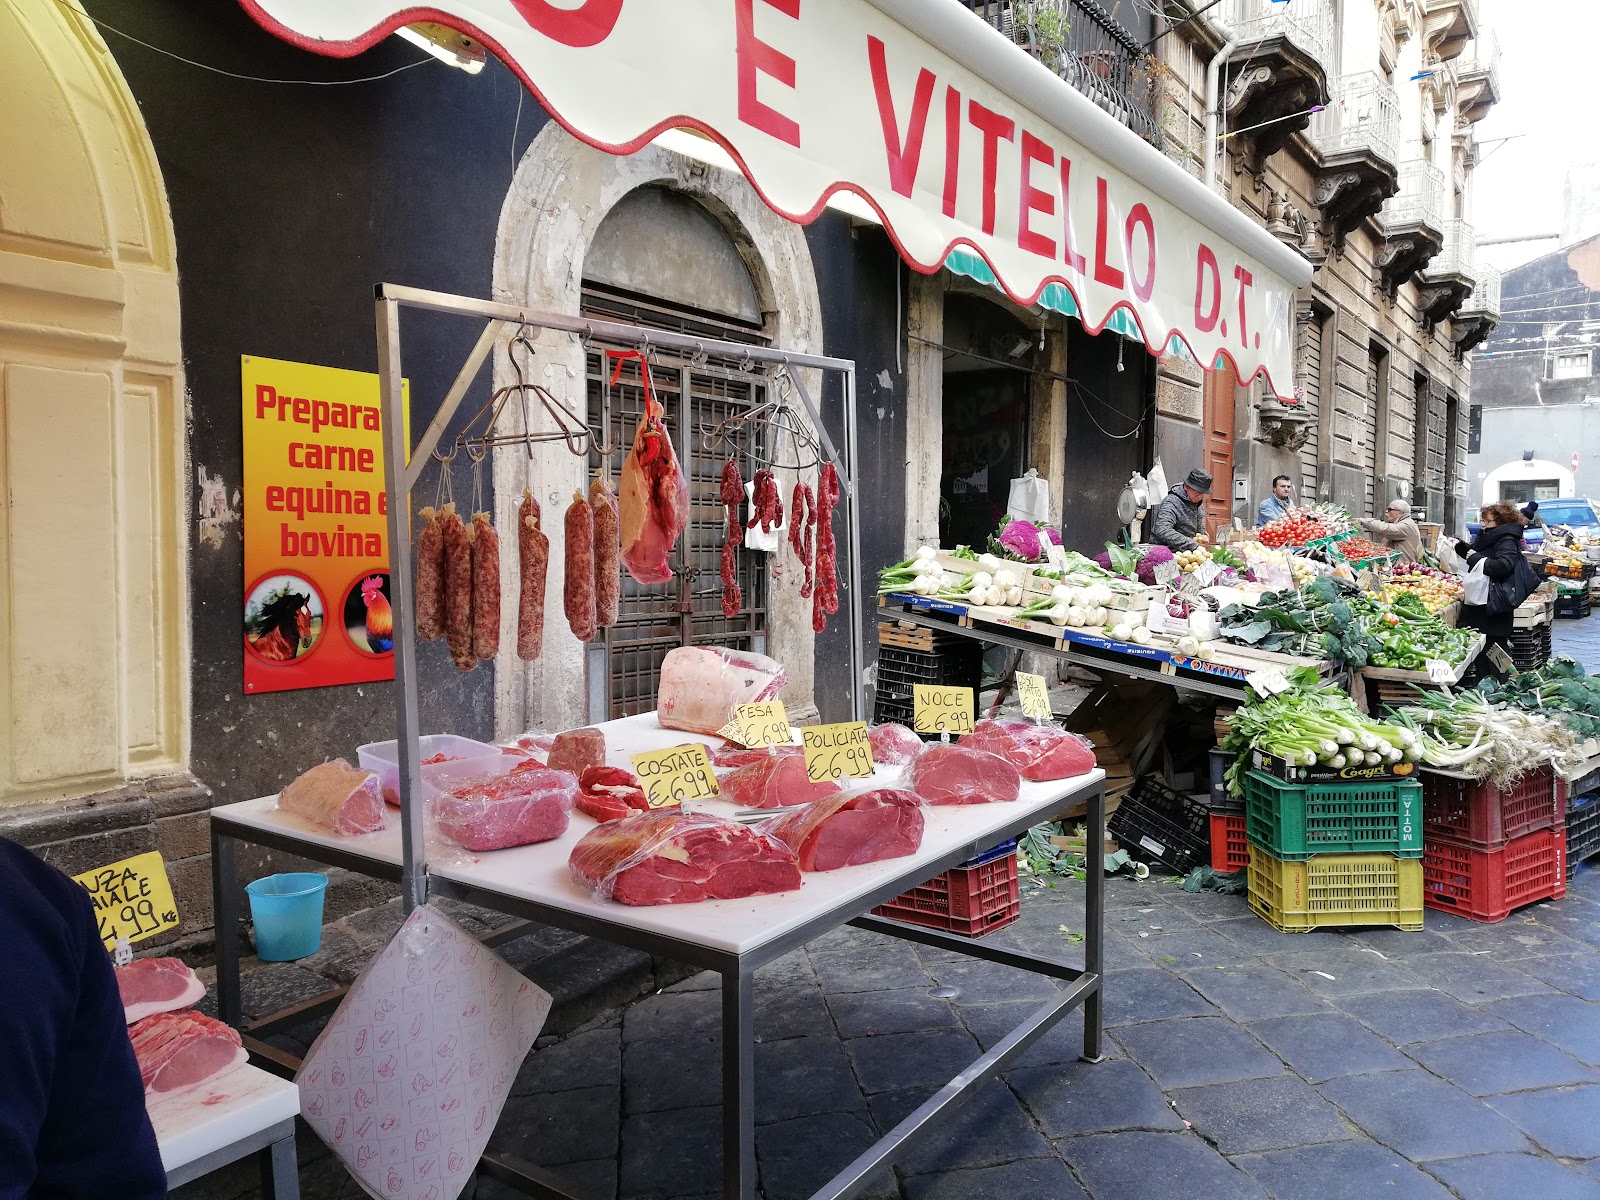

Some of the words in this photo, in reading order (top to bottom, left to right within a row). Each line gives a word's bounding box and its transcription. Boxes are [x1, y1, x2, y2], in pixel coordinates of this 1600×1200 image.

[735, 0, 801, 149] E
[866, 33, 1156, 304] VITELLO
[255, 384, 382, 433] Prepara
[288, 442, 374, 473] carne
[265, 481, 371, 520] equina
[280, 522, 382, 558] bovina
[736, 704, 774, 720] FESA
[919, 691, 964, 707] NOCE
[635, 749, 705, 778] COSTATE
[1339, 764, 1386, 779] Coagri
[1402, 800, 1413, 841] MOTTA
[91, 876, 152, 911] AIALE
